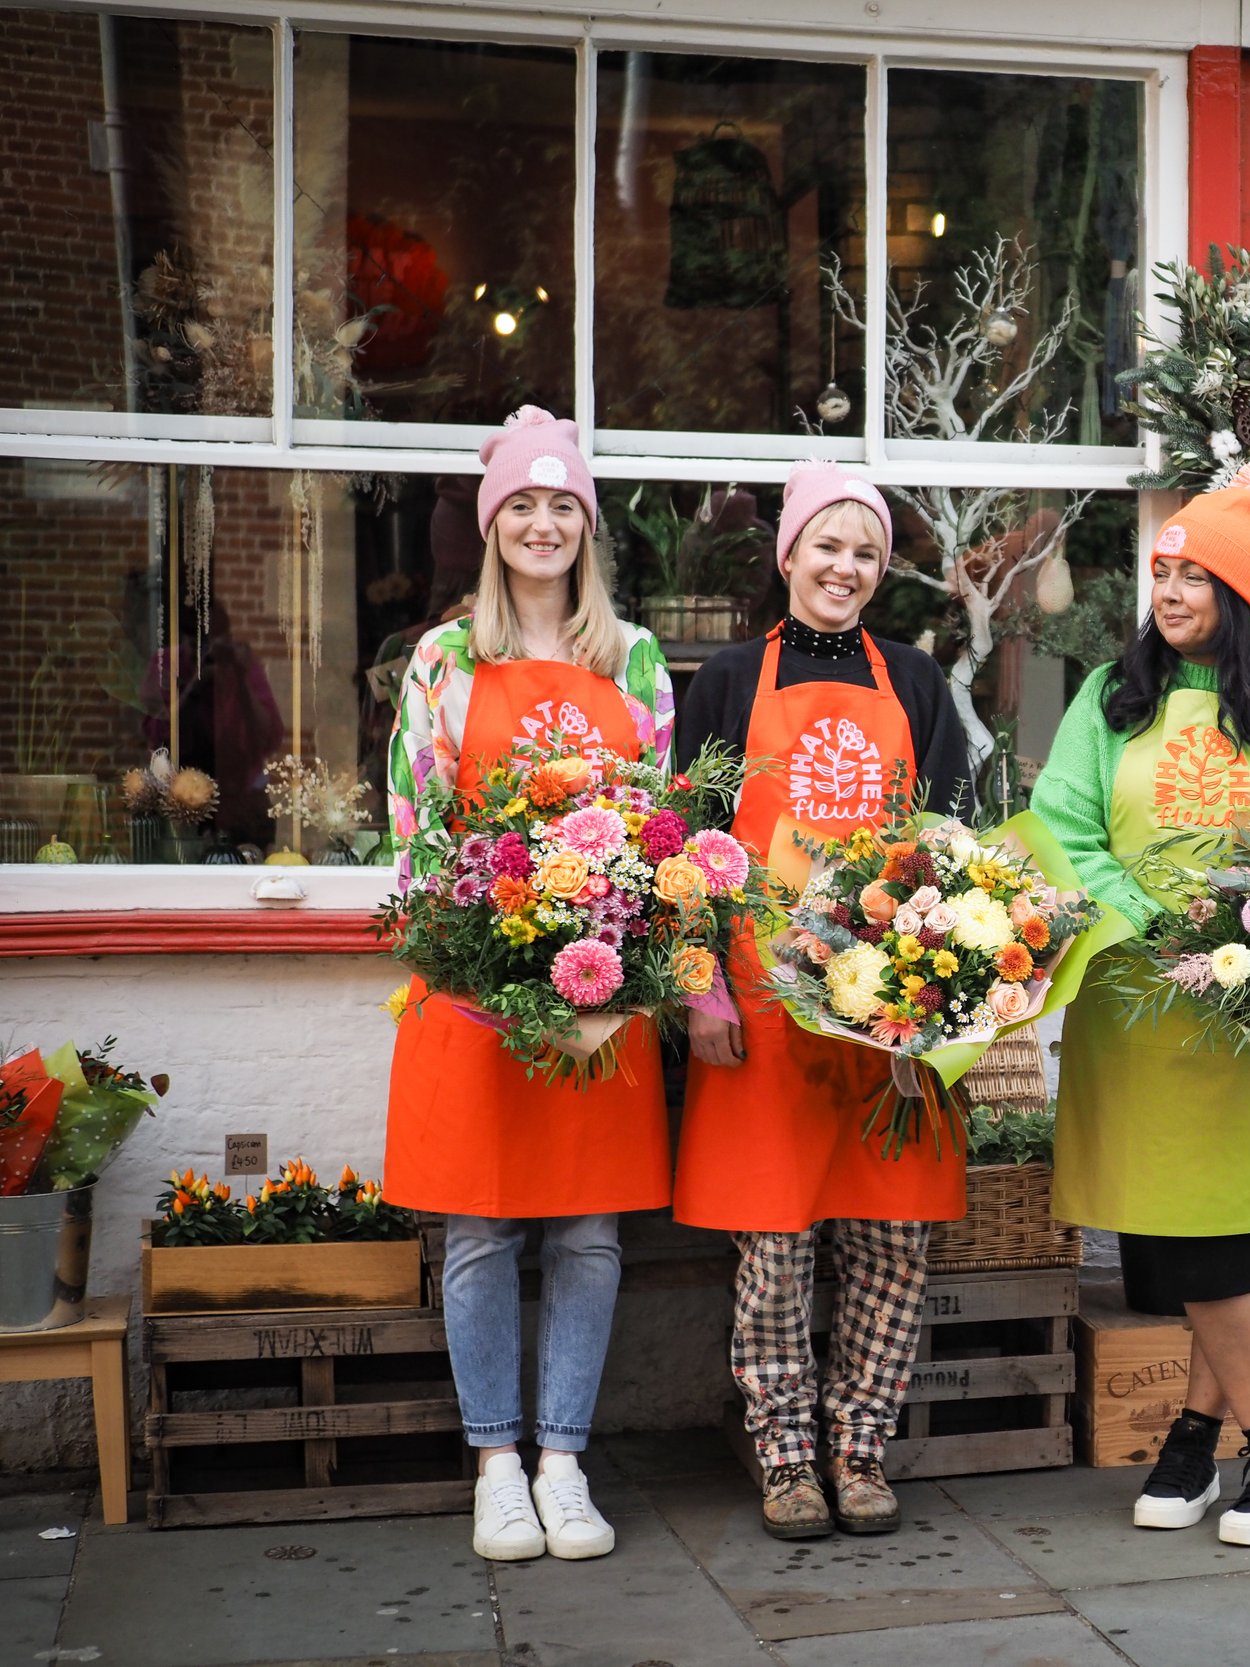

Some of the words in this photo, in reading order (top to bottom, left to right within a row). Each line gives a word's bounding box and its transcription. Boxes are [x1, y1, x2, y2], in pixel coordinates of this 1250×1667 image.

[789, 717, 832, 799] WHAT
[859, 742, 883, 800] THE
[1154, 725, 1197, 806] WHAT
